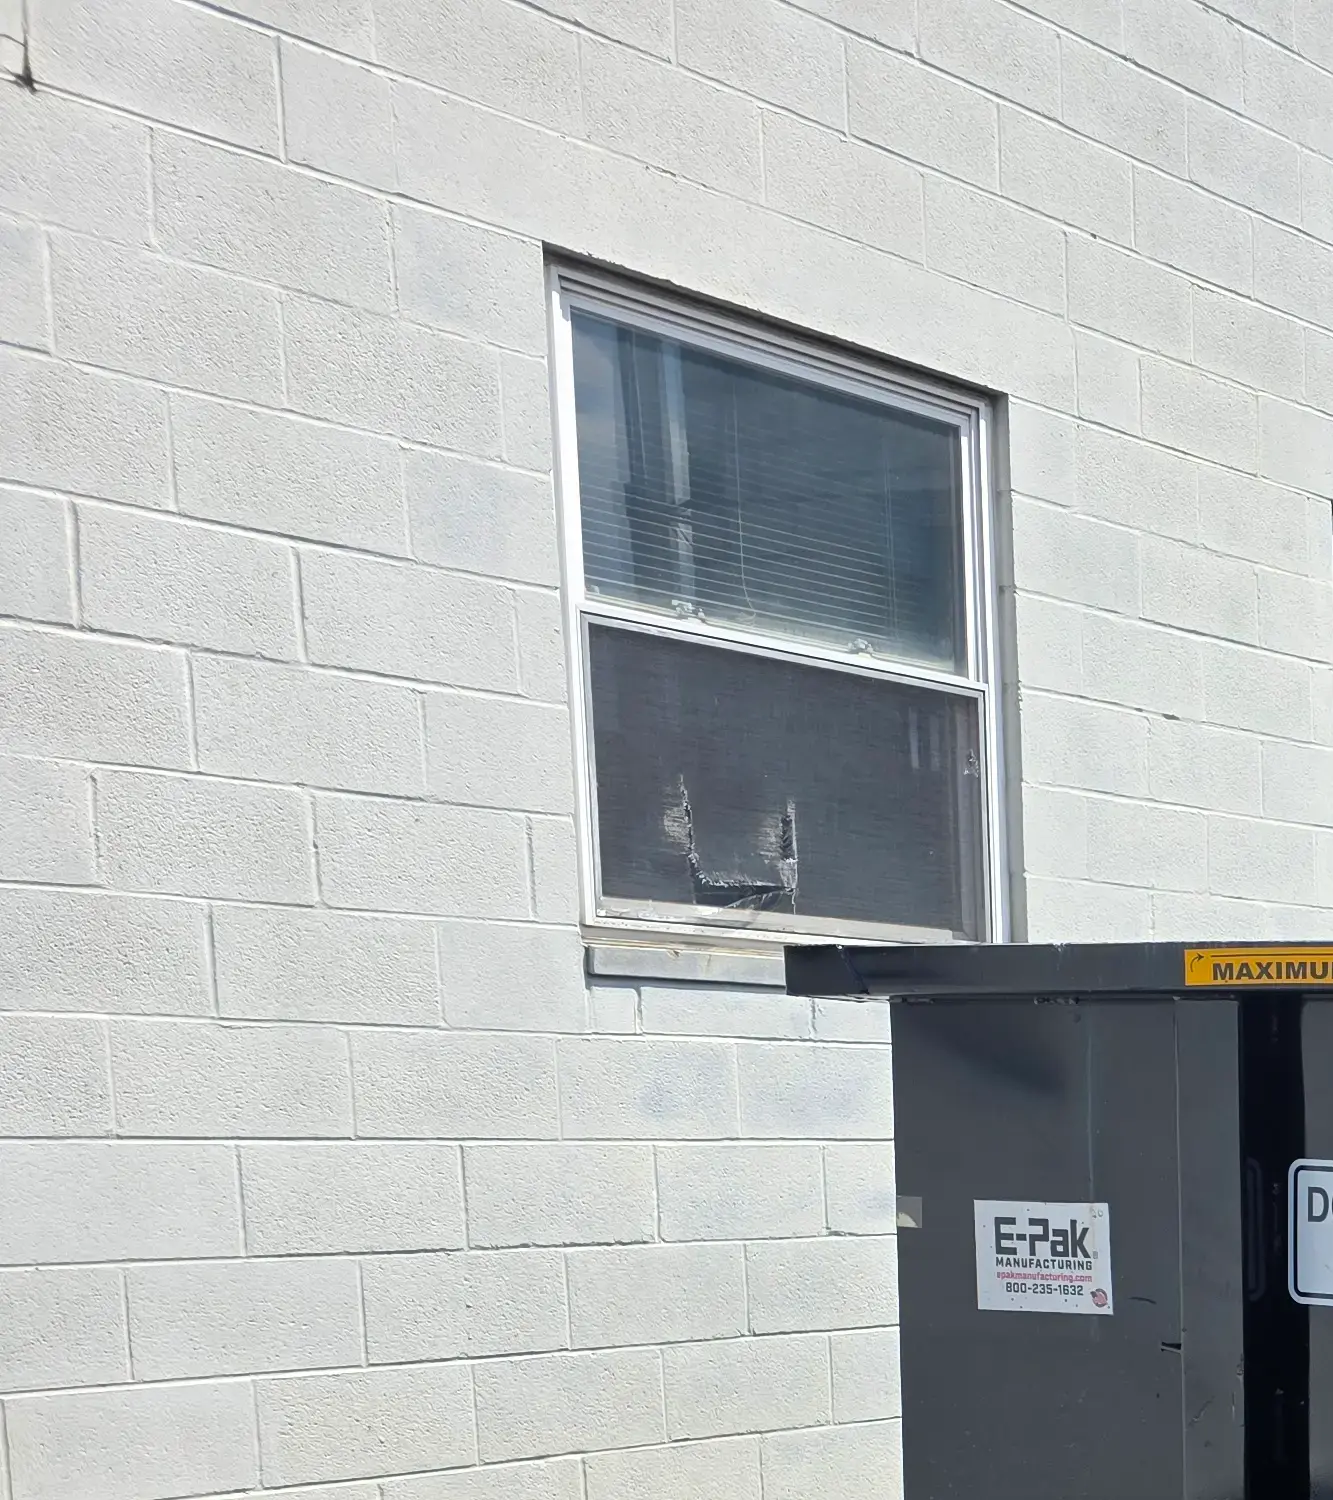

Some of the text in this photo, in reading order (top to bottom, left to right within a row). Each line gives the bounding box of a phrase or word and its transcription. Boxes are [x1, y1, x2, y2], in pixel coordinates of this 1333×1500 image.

[994, 1216, 1091, 1259] E-Pak
[995, 1256, 1093, 1271] MANUFACTURING
[996, 1270, 1093, 1283] epakmanufacturing.com
[1005, 1282, 1084, 1296] 800-235-1632
